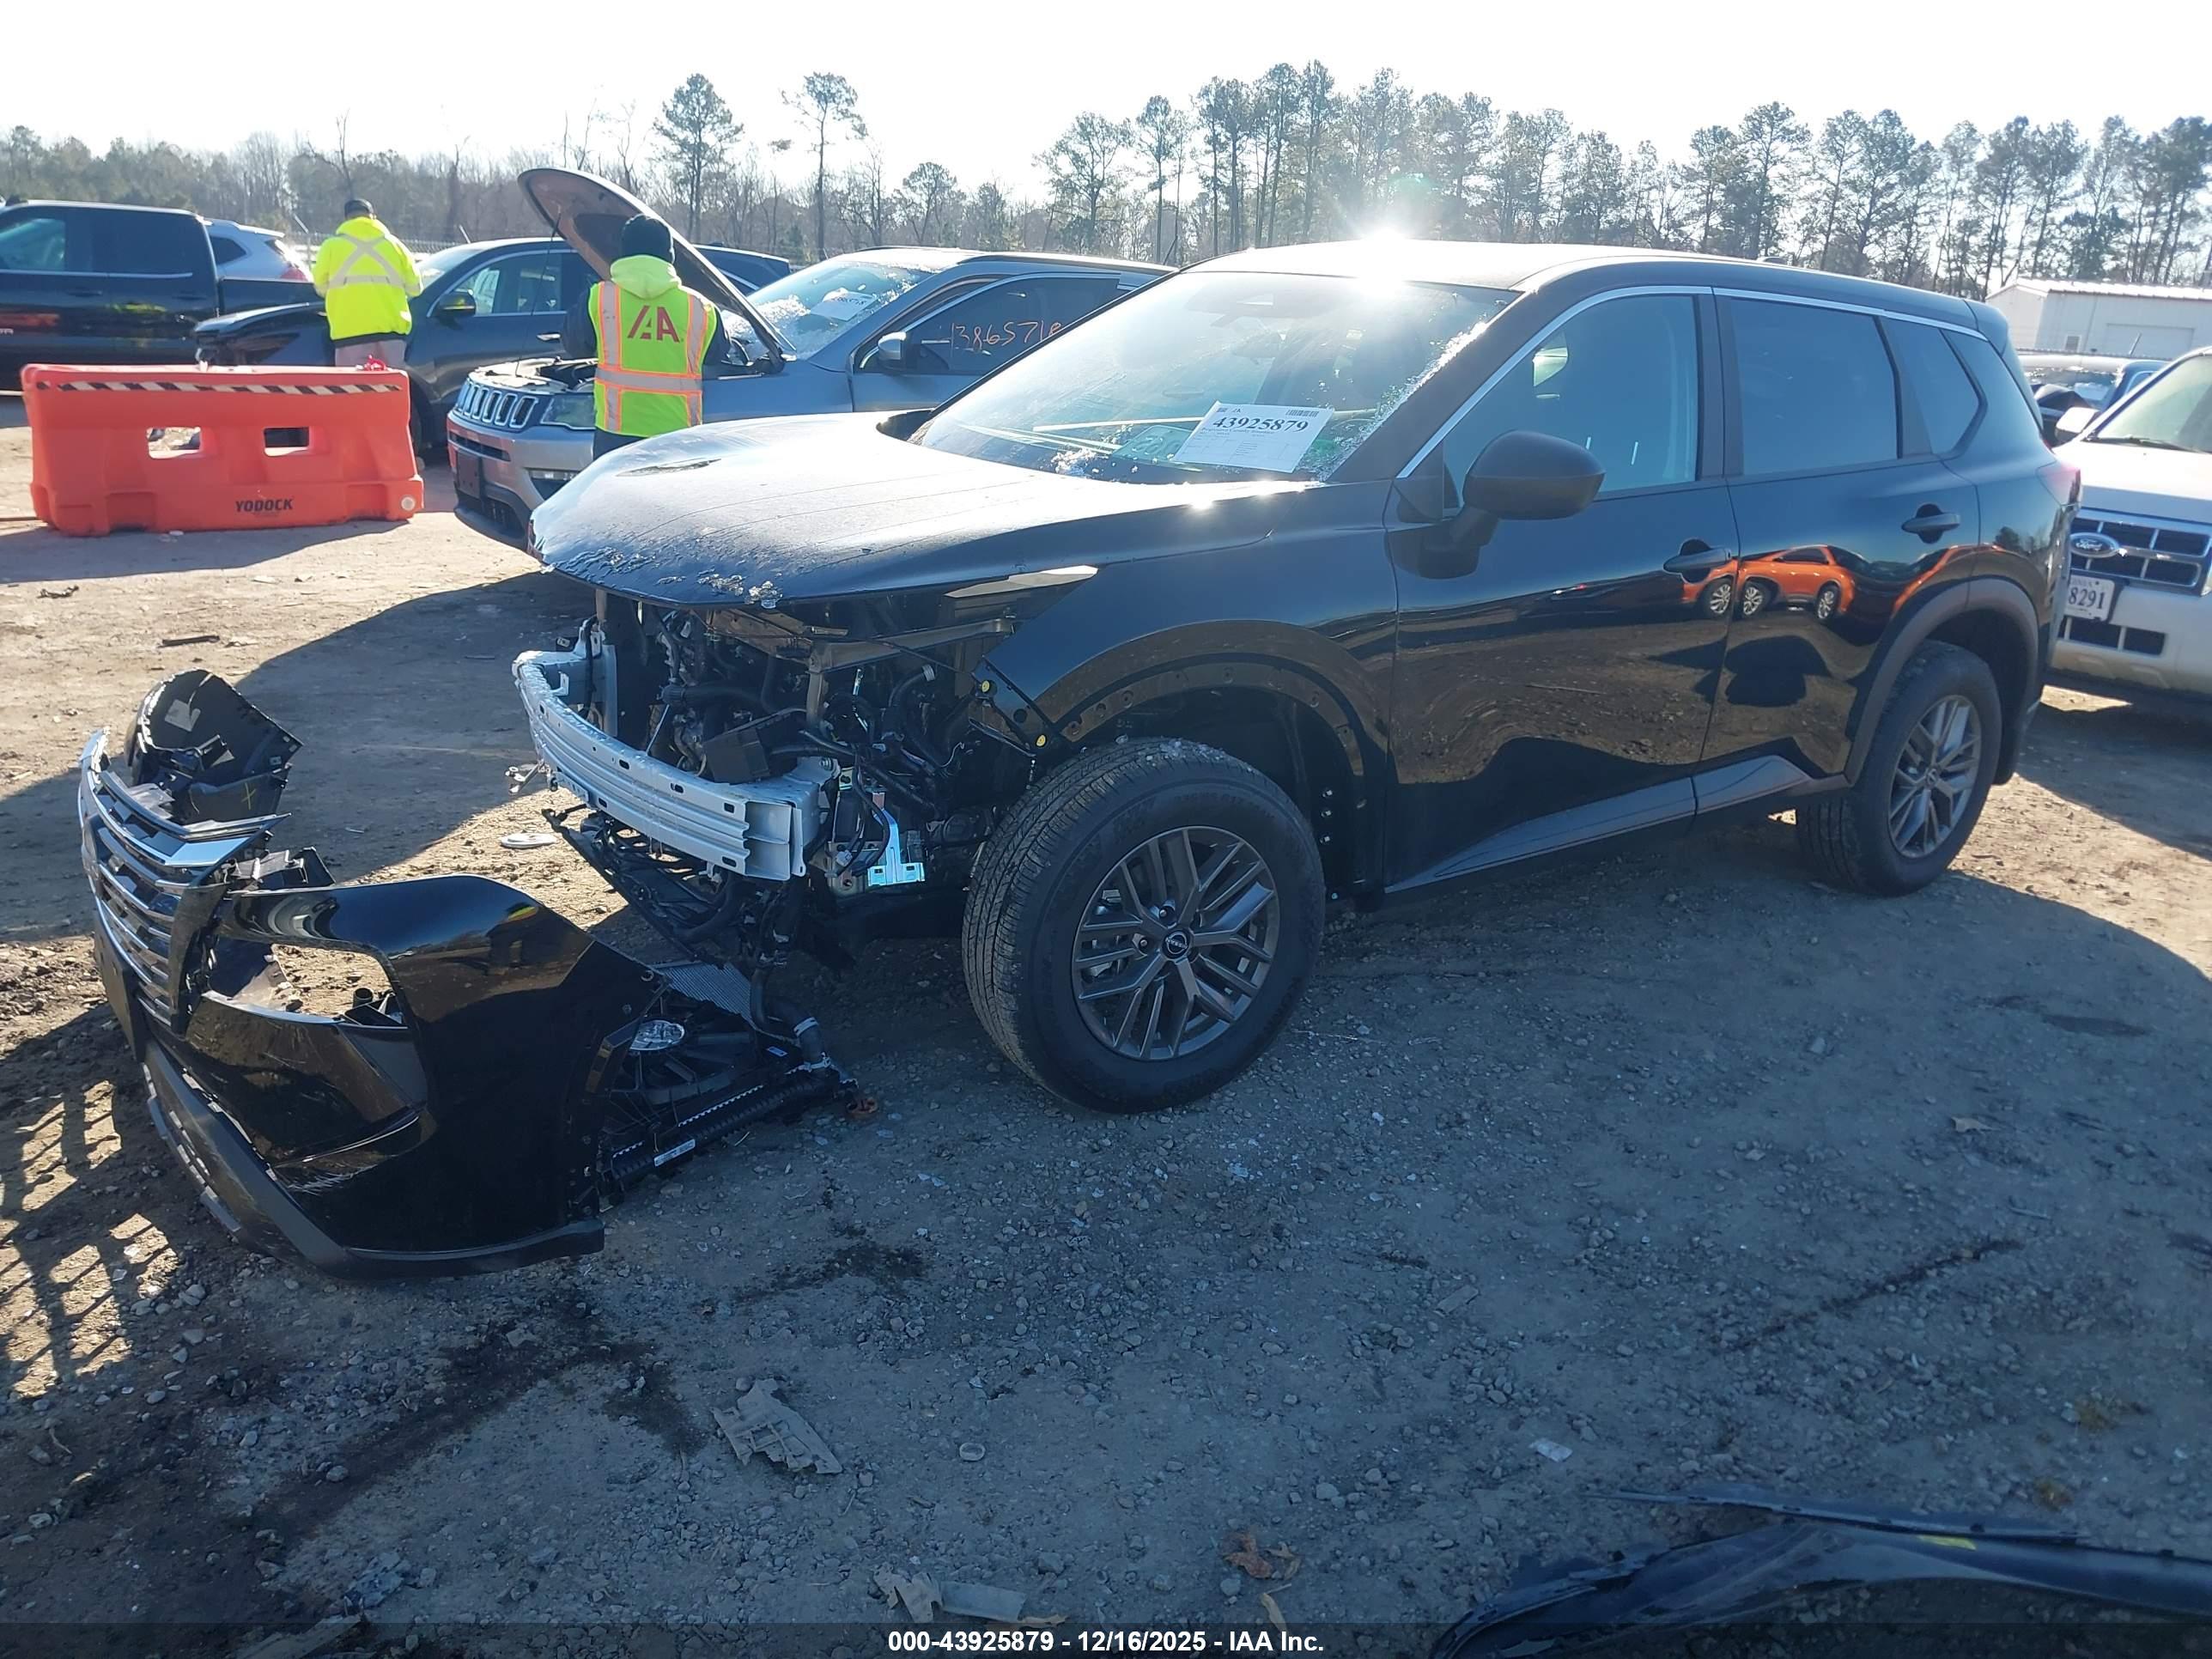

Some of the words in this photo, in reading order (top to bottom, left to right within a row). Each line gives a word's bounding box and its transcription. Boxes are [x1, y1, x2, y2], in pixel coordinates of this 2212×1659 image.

[1212, 416, 1310, 432] 43925879
[234, 498, 294, 513] YODOCK
[2068, 586, 2106, 610] 8291
